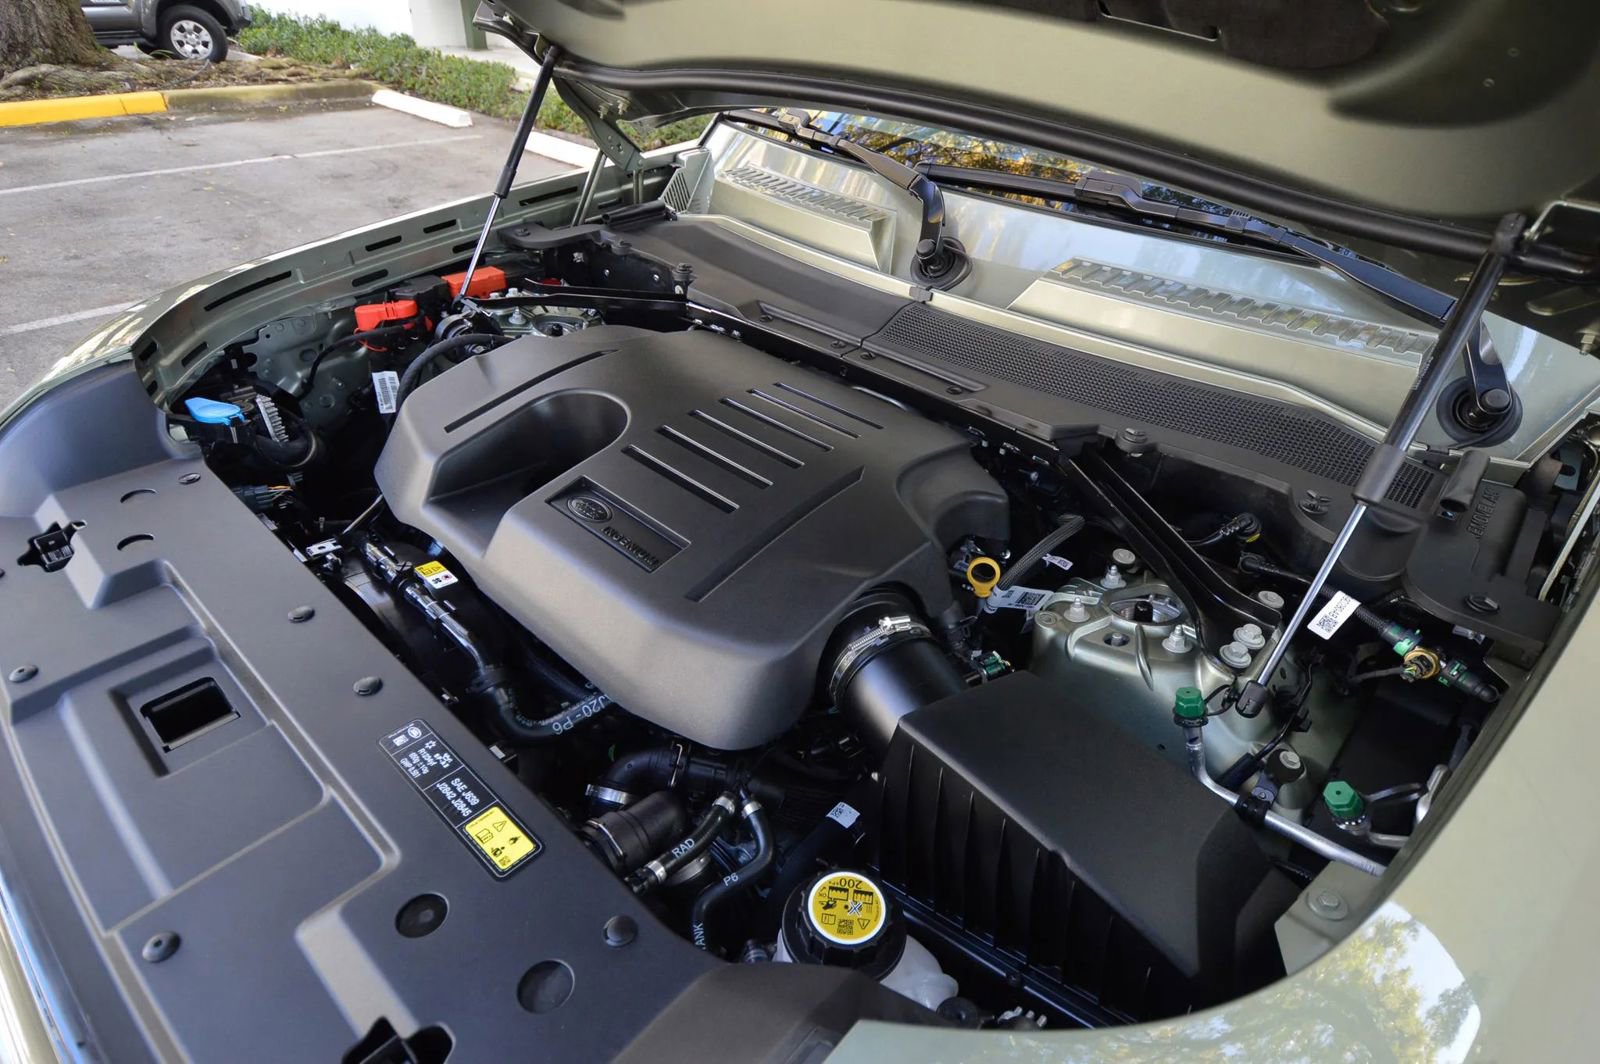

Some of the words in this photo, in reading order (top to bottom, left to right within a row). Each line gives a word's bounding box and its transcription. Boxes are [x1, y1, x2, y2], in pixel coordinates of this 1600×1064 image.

[436, 782, 457, 800] J2842
[451, 798, 472, 817] J2845
[451, 778, 468, 793] SAE
[461, 791, 480, 806] J639
[671, 838, 695, 858] RAD
[723, 872, 739, 887] P6
[693, 922, 707, 950] ANK
